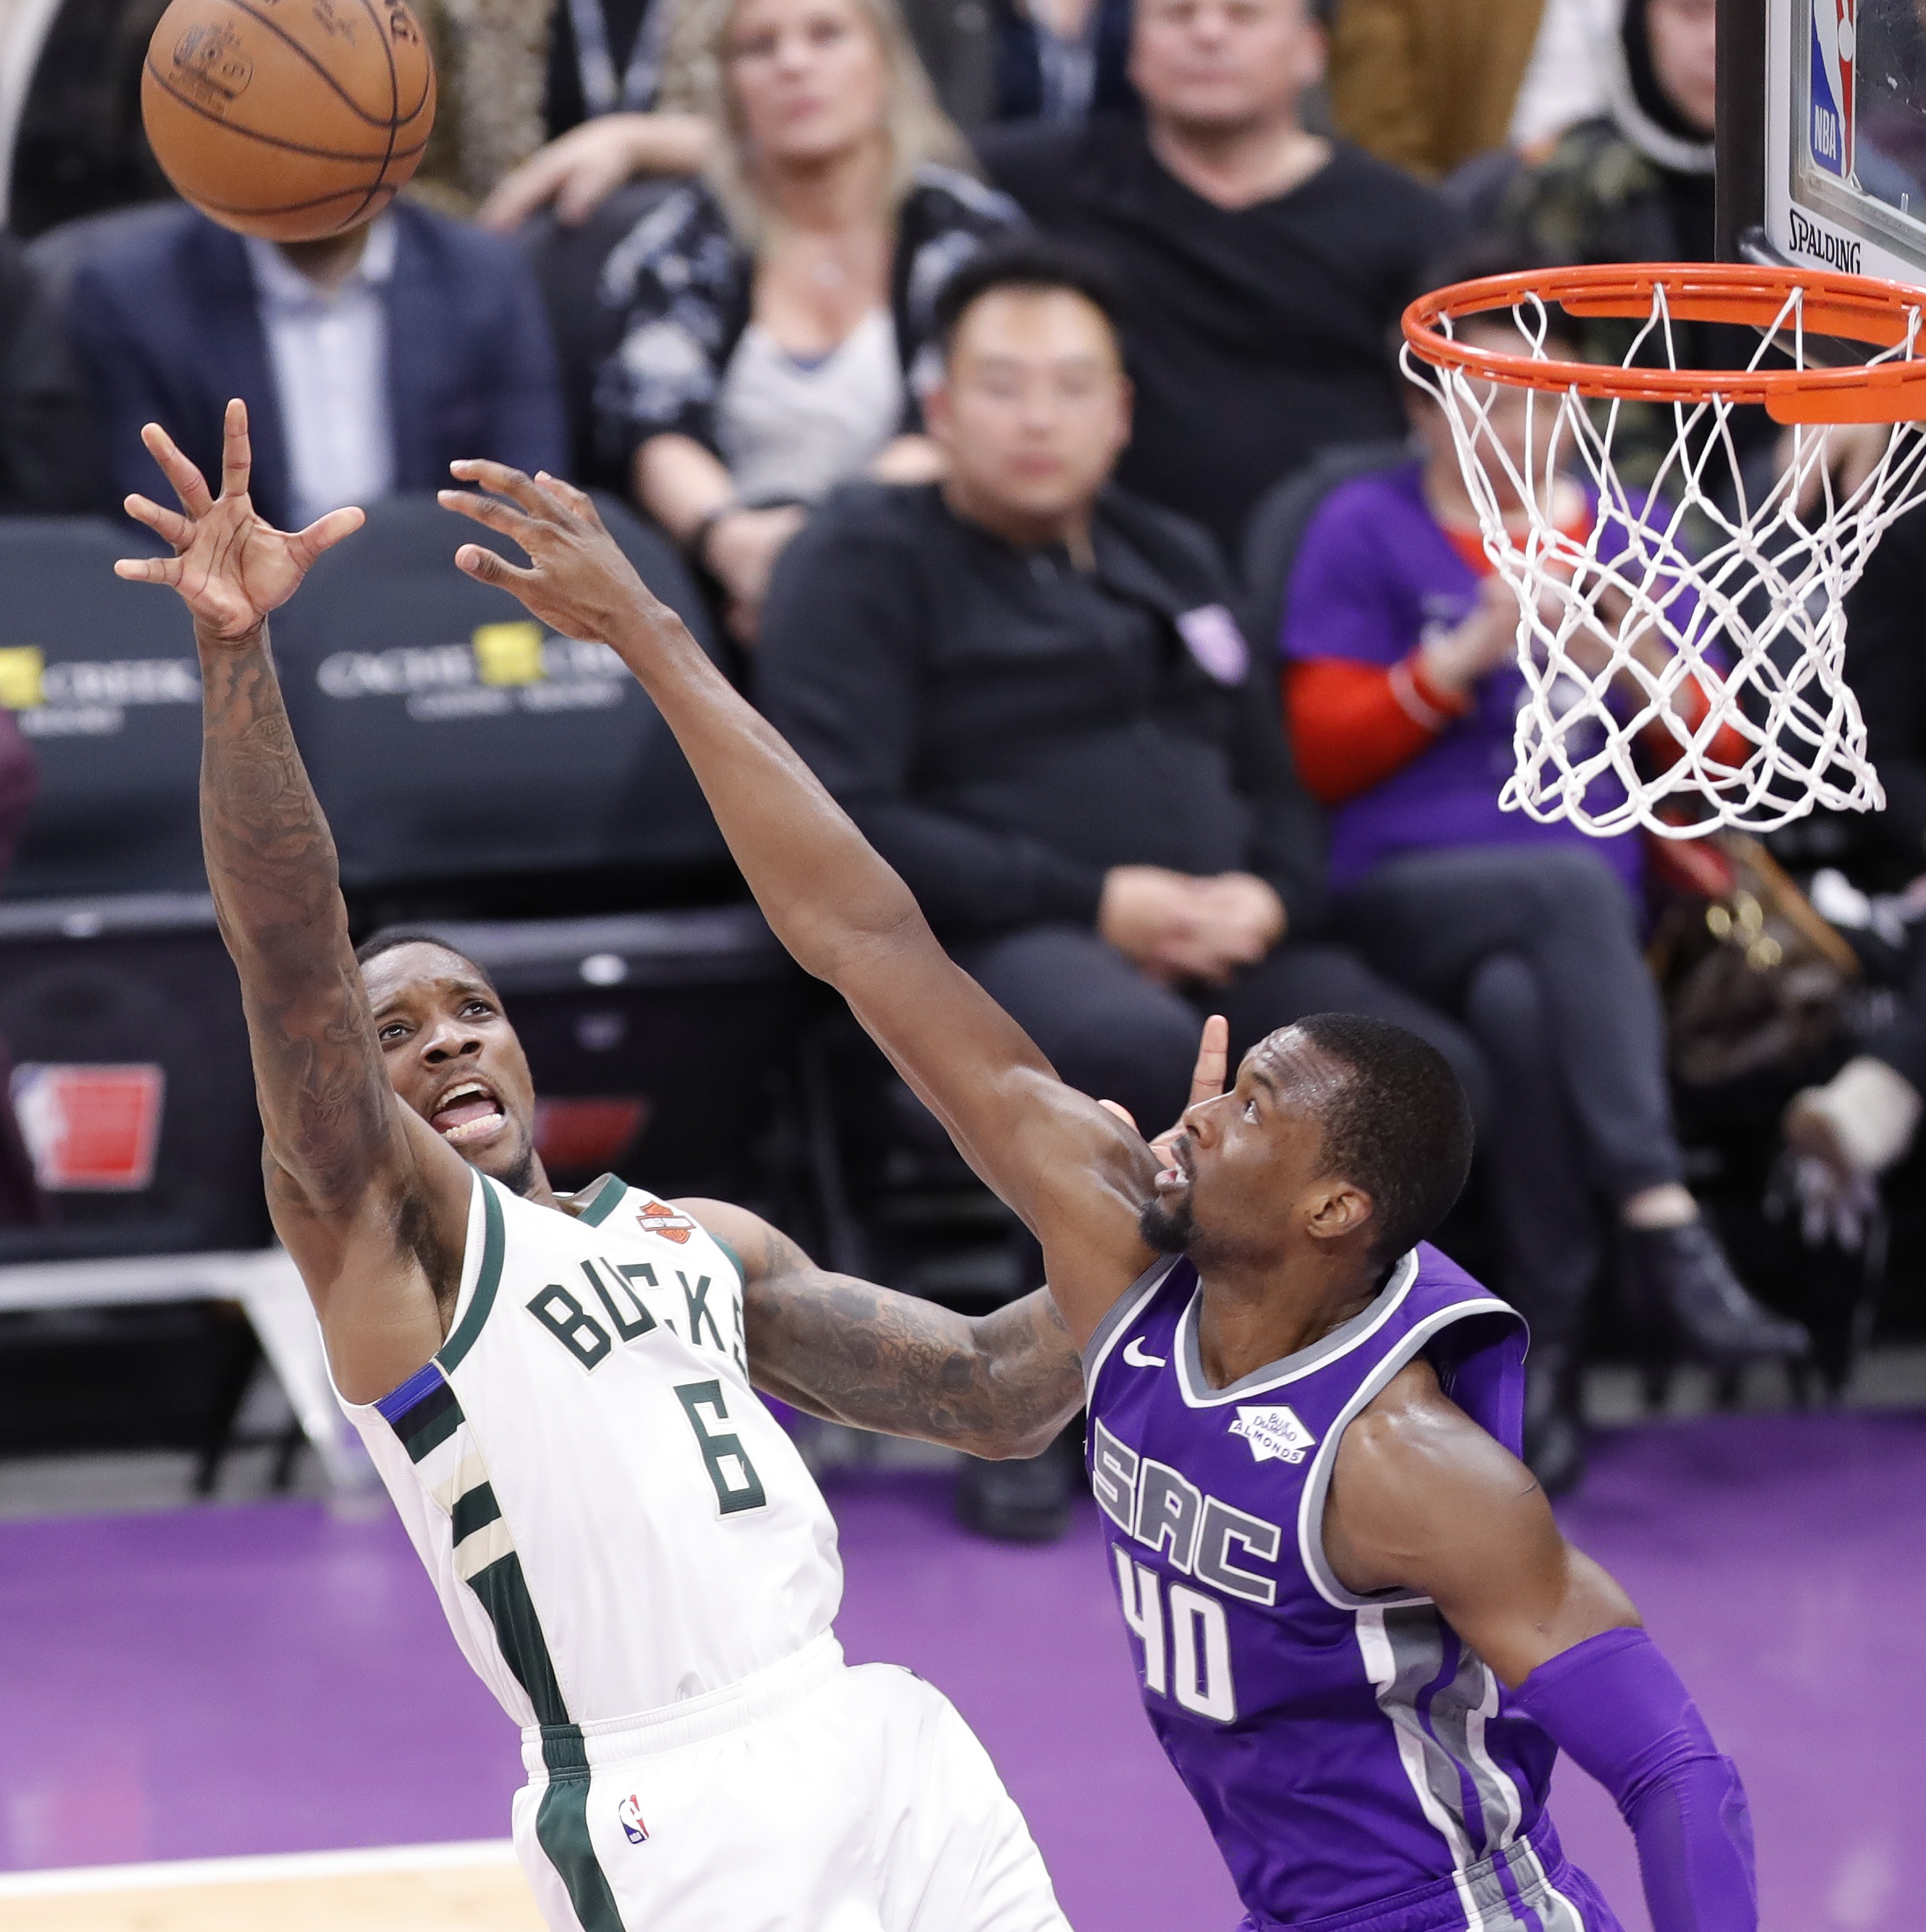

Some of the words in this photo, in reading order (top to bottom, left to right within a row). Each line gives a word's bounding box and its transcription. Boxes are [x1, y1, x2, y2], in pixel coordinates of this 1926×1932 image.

[1814, 104, 1838, 161] NBA
[1789, 208, 1861, 275] SPALDING
[672, 1378, 768, 1517] 6
[1233, 1422, 1300, 1461] ALMONDS
[1093, 1417, 1282, 1607] SAC
[1112, 1542, 1238, 1725] 40
